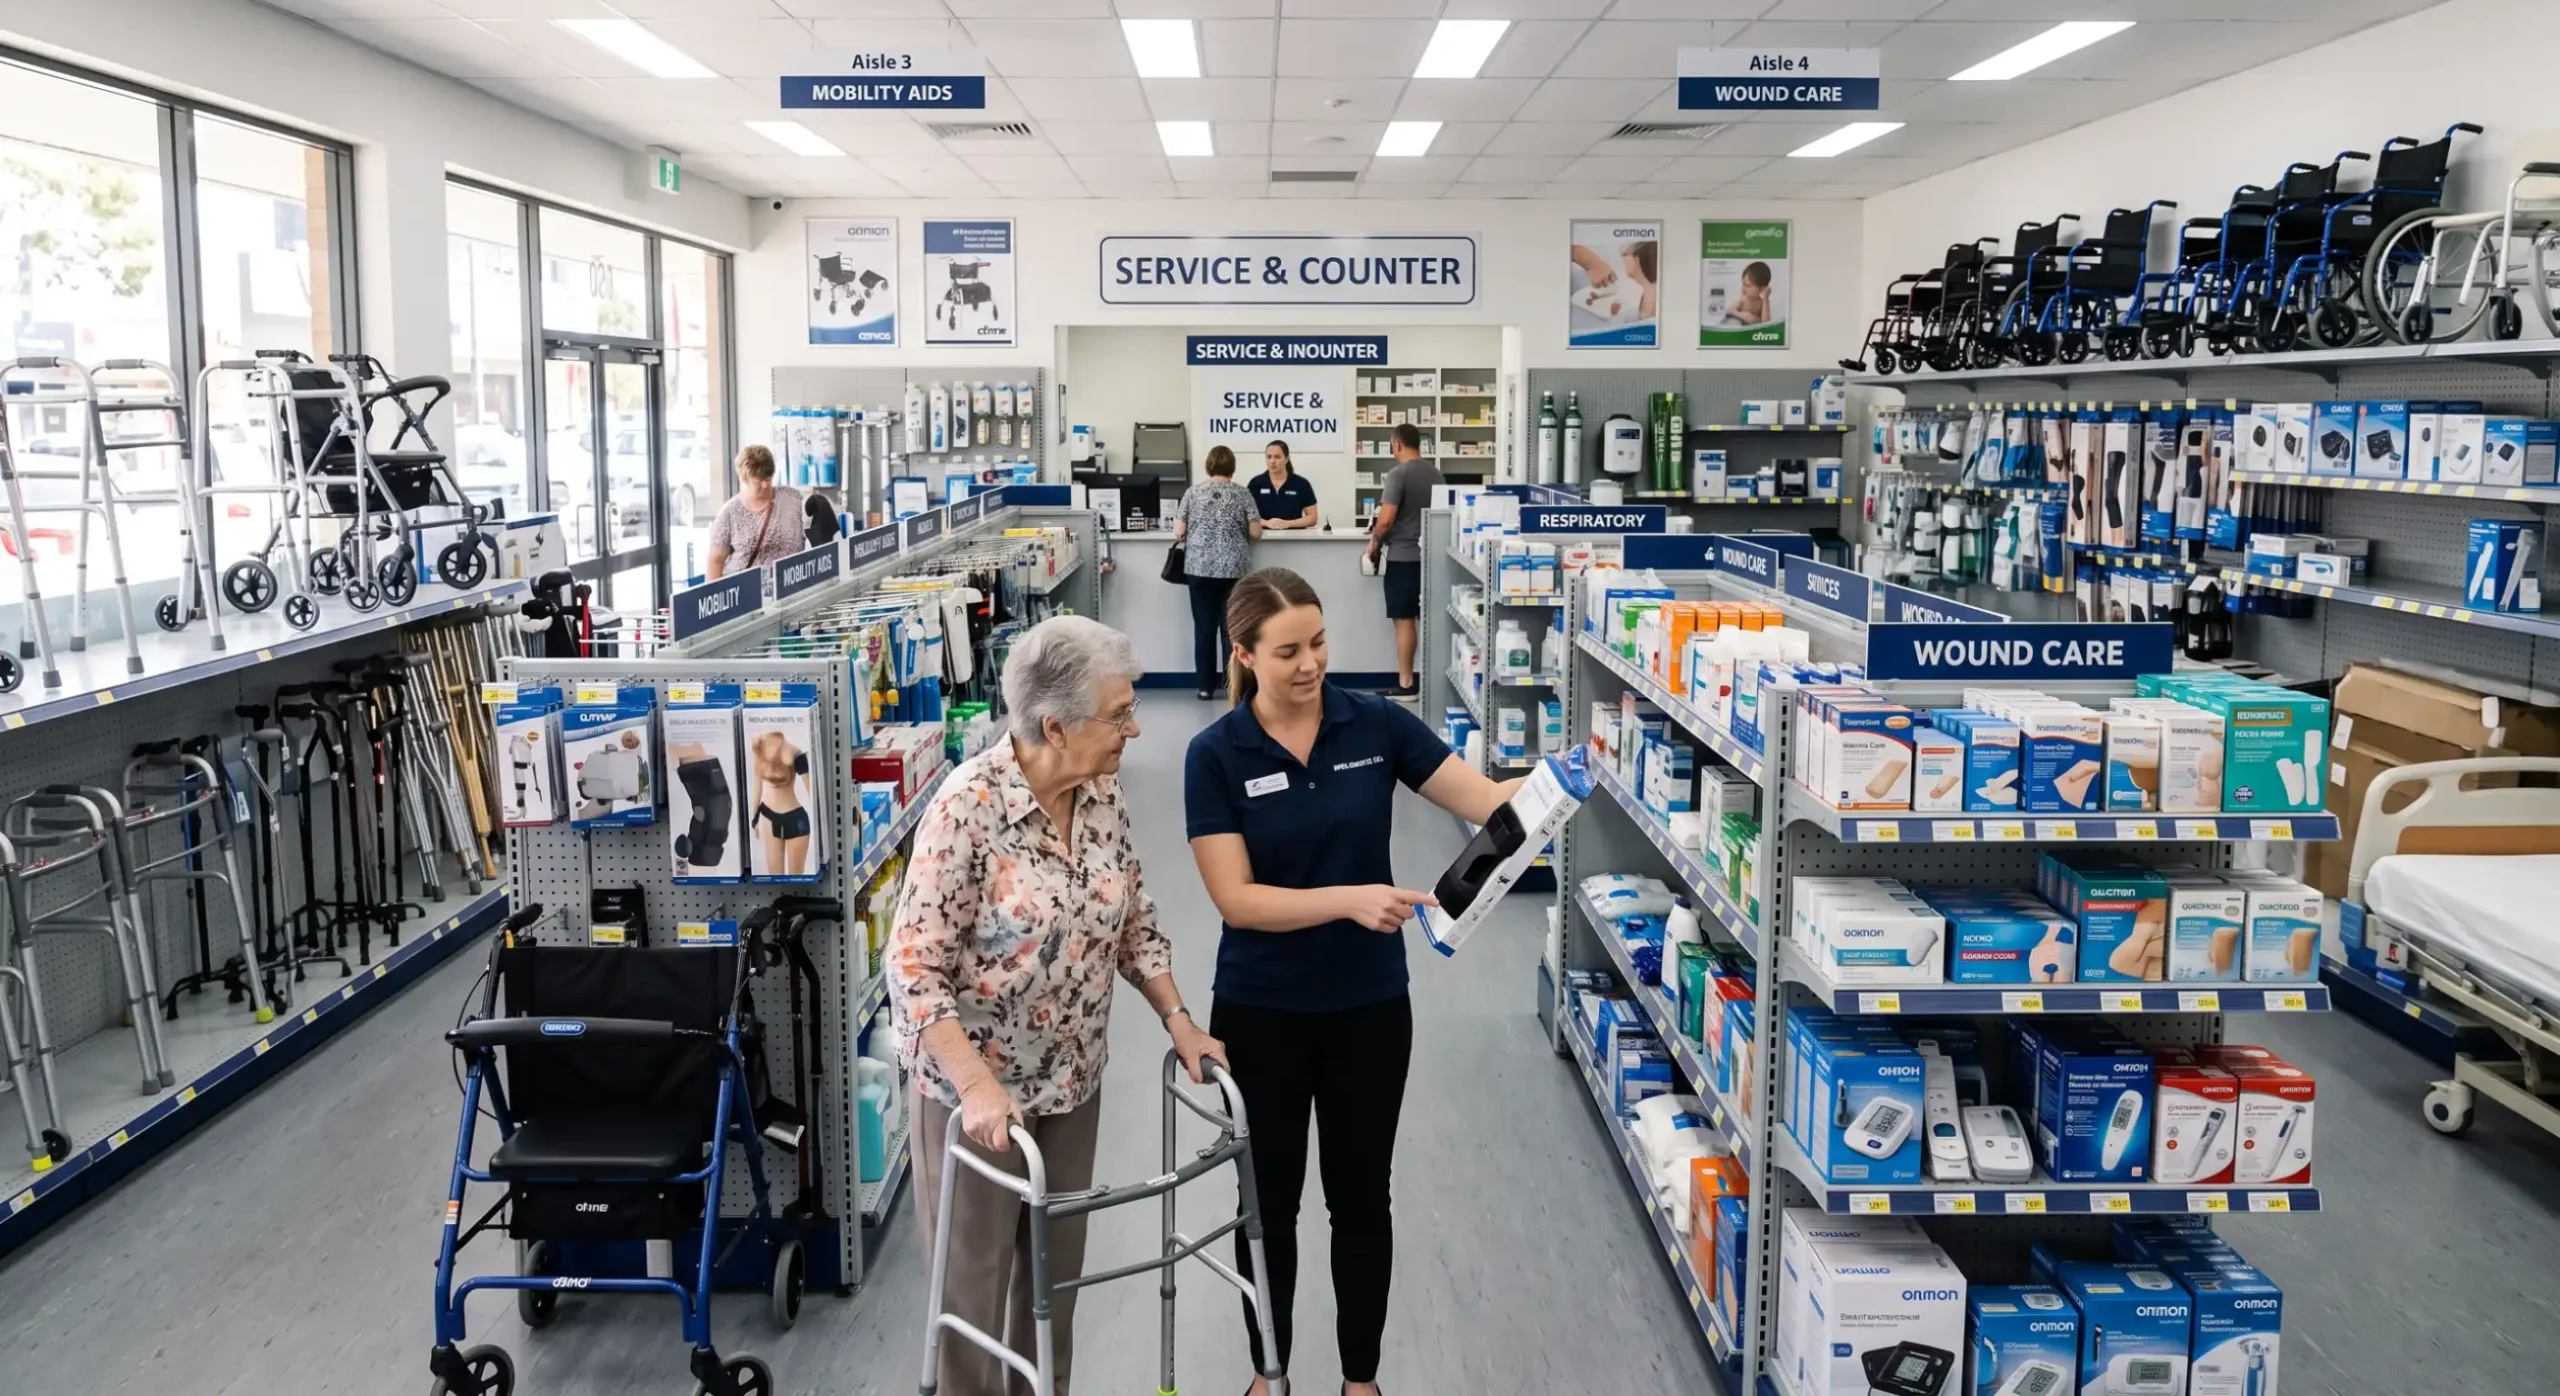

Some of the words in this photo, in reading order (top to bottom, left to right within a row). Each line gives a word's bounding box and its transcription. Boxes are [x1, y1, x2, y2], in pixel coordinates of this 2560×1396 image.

[852, 53, 897, 70] Aisle
[901, 54, 912, 70] 3
[1749, 55, 1794, 71] Aisle
[1798, 56, 1810, 71] 4
[812, 84, 904, 101] MOBILITY
[908, 84, 953, 101] AIDS
[1714, 86, 1790, 102] WOUND
[1793, 86, 1843, 102] CARE
[1115, 256, 1252, 285] SERVICE
[1262, 256, 1288, 285] &
[1299, 256, 1461, 285] COUNTER
[1195, 343, 1267, 359] SERVICE
[1270, 343, 1284, 359] &
[1287, 343, 1379, 359] INOUNTER
[1223, 392, 1305, 409] SERVICE
[1309, 392, 1324, 409] &
[1209, 417, 1337, 434] INFORMATION
[1539, 514, 1647, 527] RESPIRATORY
[783, 559, 817, 587] MOBILITY
[817, 553, 833, 574] AIDS
[1748, 550, 1767, 576] CARE
[698, 585, 741, 620] MOBILITY
[1913, 640, 2034, 666] WOUND
[2042, 640, 2124, 666] CARE
